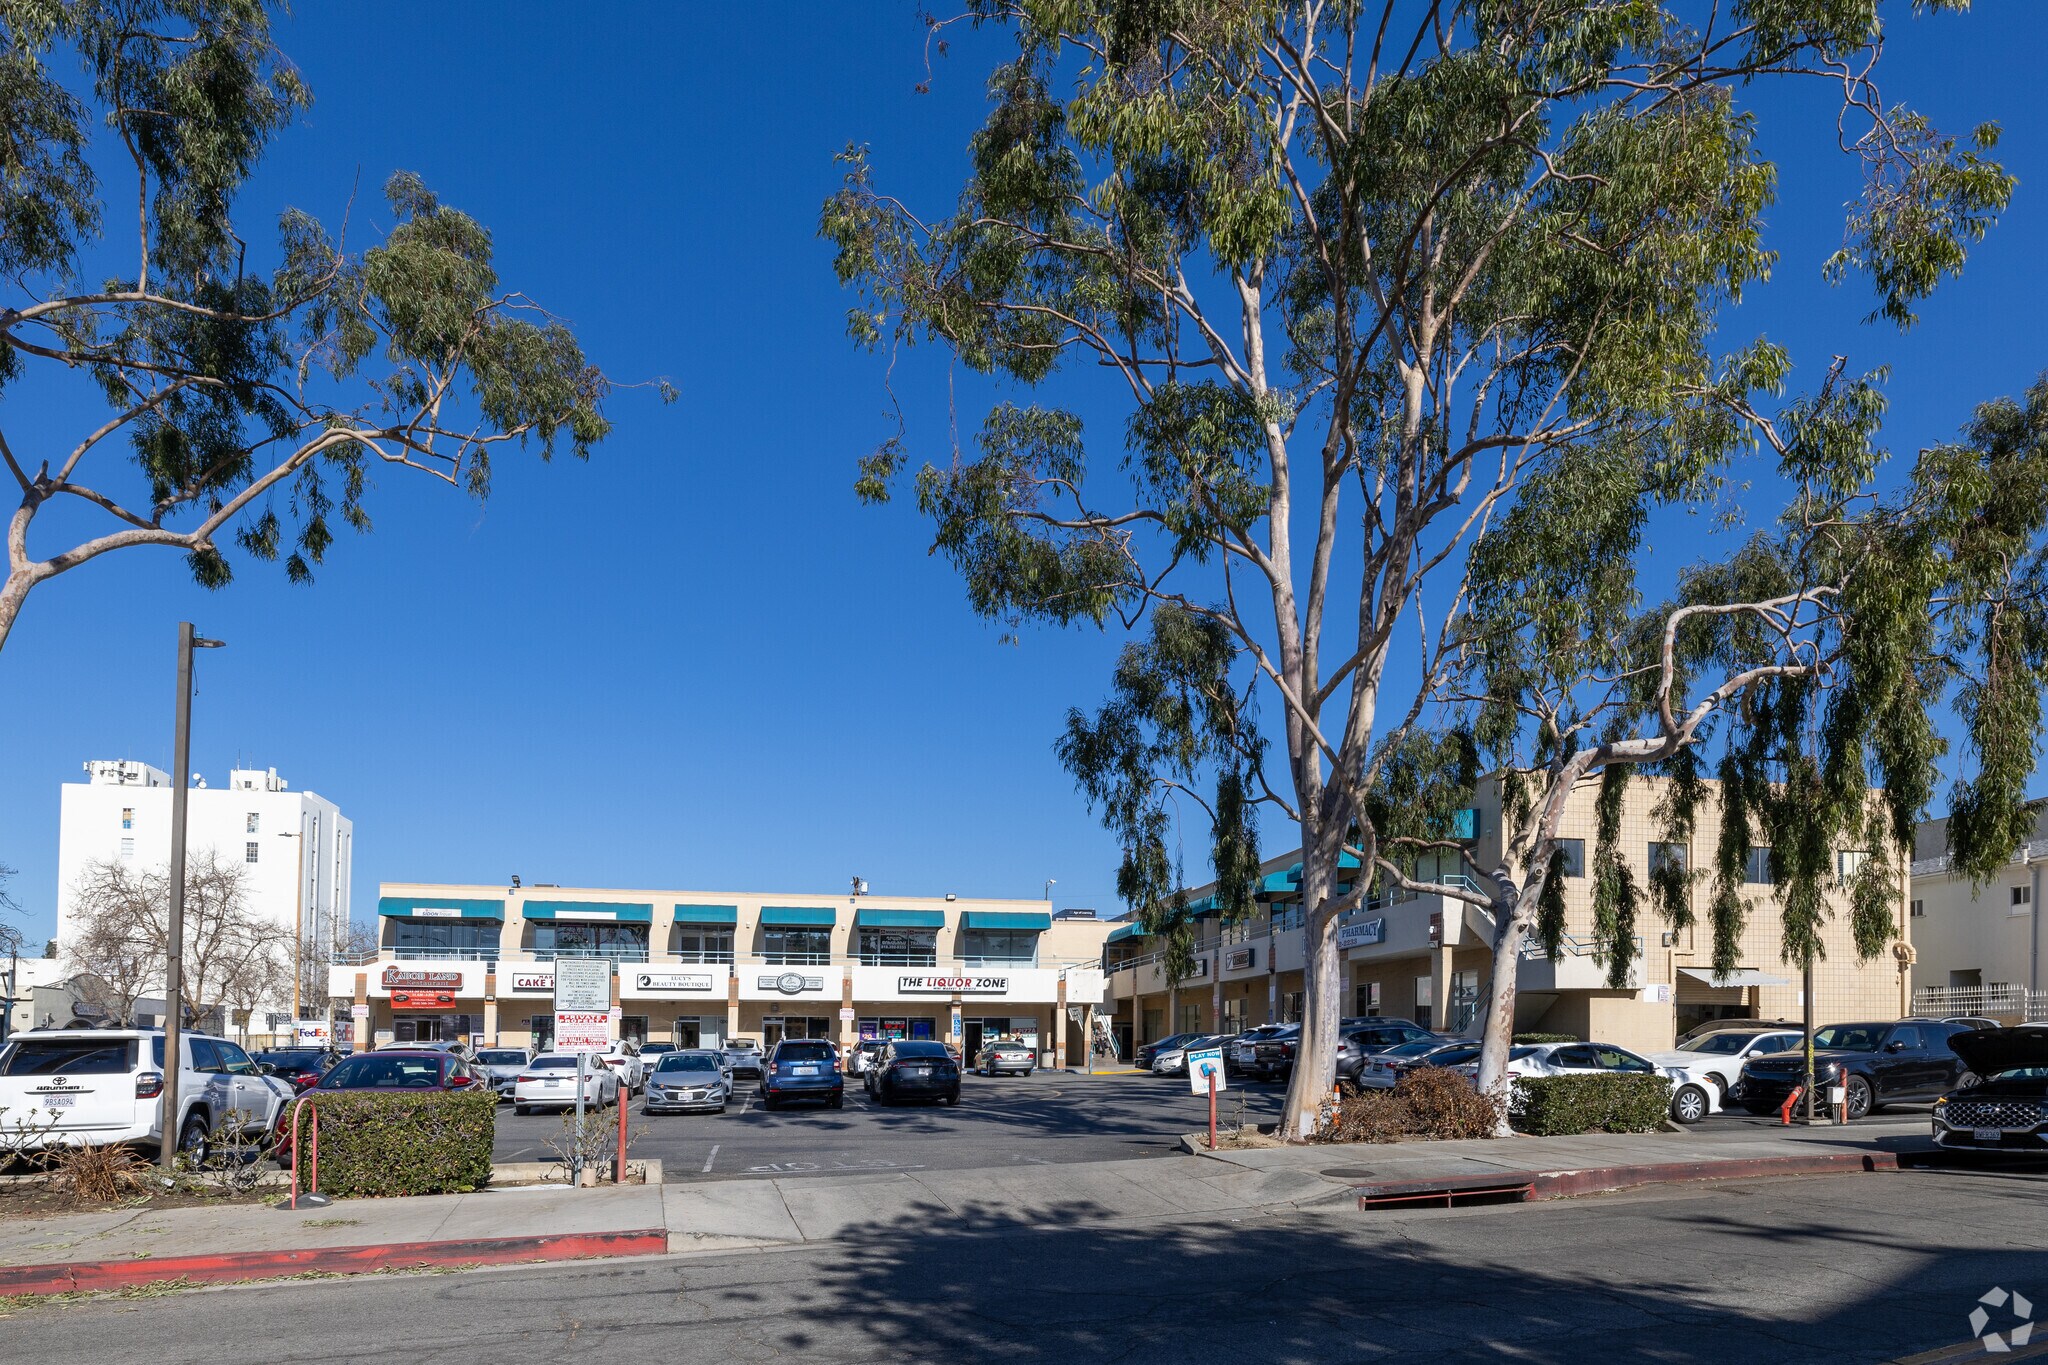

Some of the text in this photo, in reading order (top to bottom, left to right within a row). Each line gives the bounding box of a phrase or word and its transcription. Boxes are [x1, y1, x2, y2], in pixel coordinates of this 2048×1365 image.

[1341, 922, 1378, 938] PHARMACY
[384, 968, 459, 983] KABOB LAND
[518, 979, 546, 987] CAKE
[902, 978, 1006, 988] THE LIQUOR ZONE
[300, 1028, 328, 1037] FedEx
